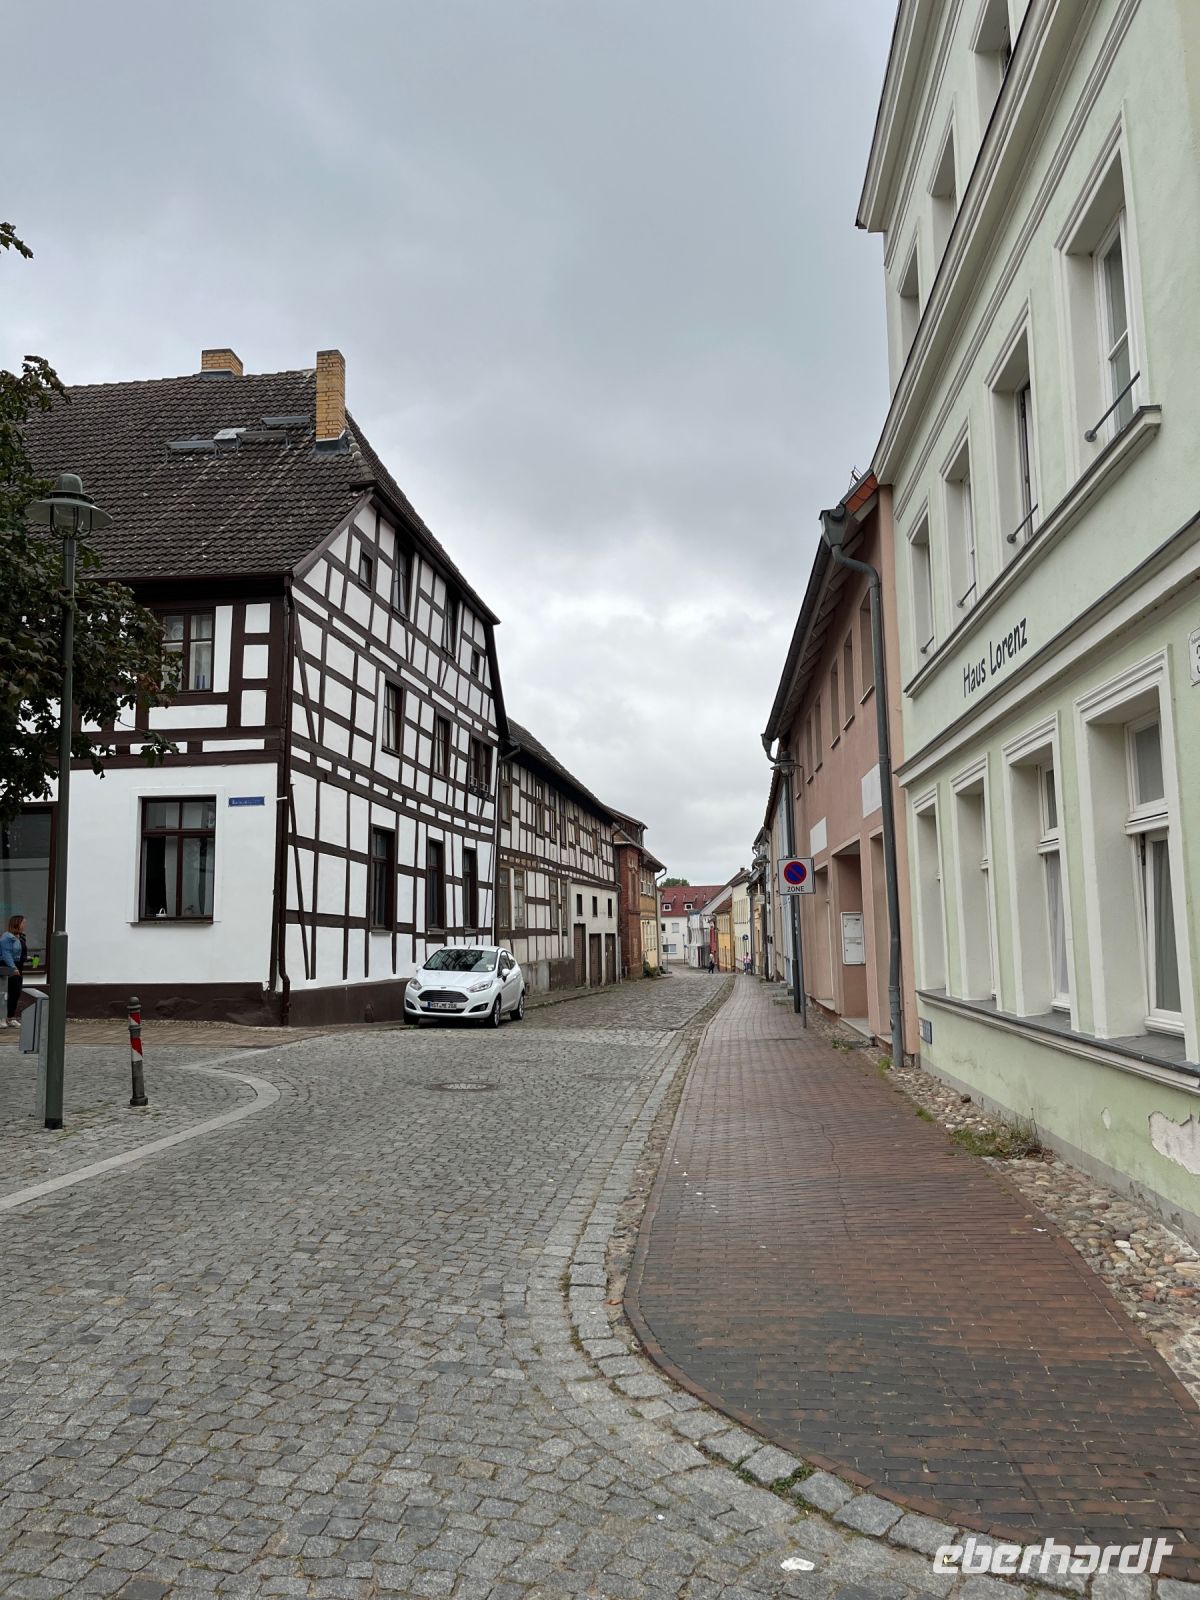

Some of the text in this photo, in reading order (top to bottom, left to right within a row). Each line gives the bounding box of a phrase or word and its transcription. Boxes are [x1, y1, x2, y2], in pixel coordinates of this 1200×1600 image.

[963, 618, 1028, 698] Haus Lorenz
[787, 885, 805, 893] ZONE
